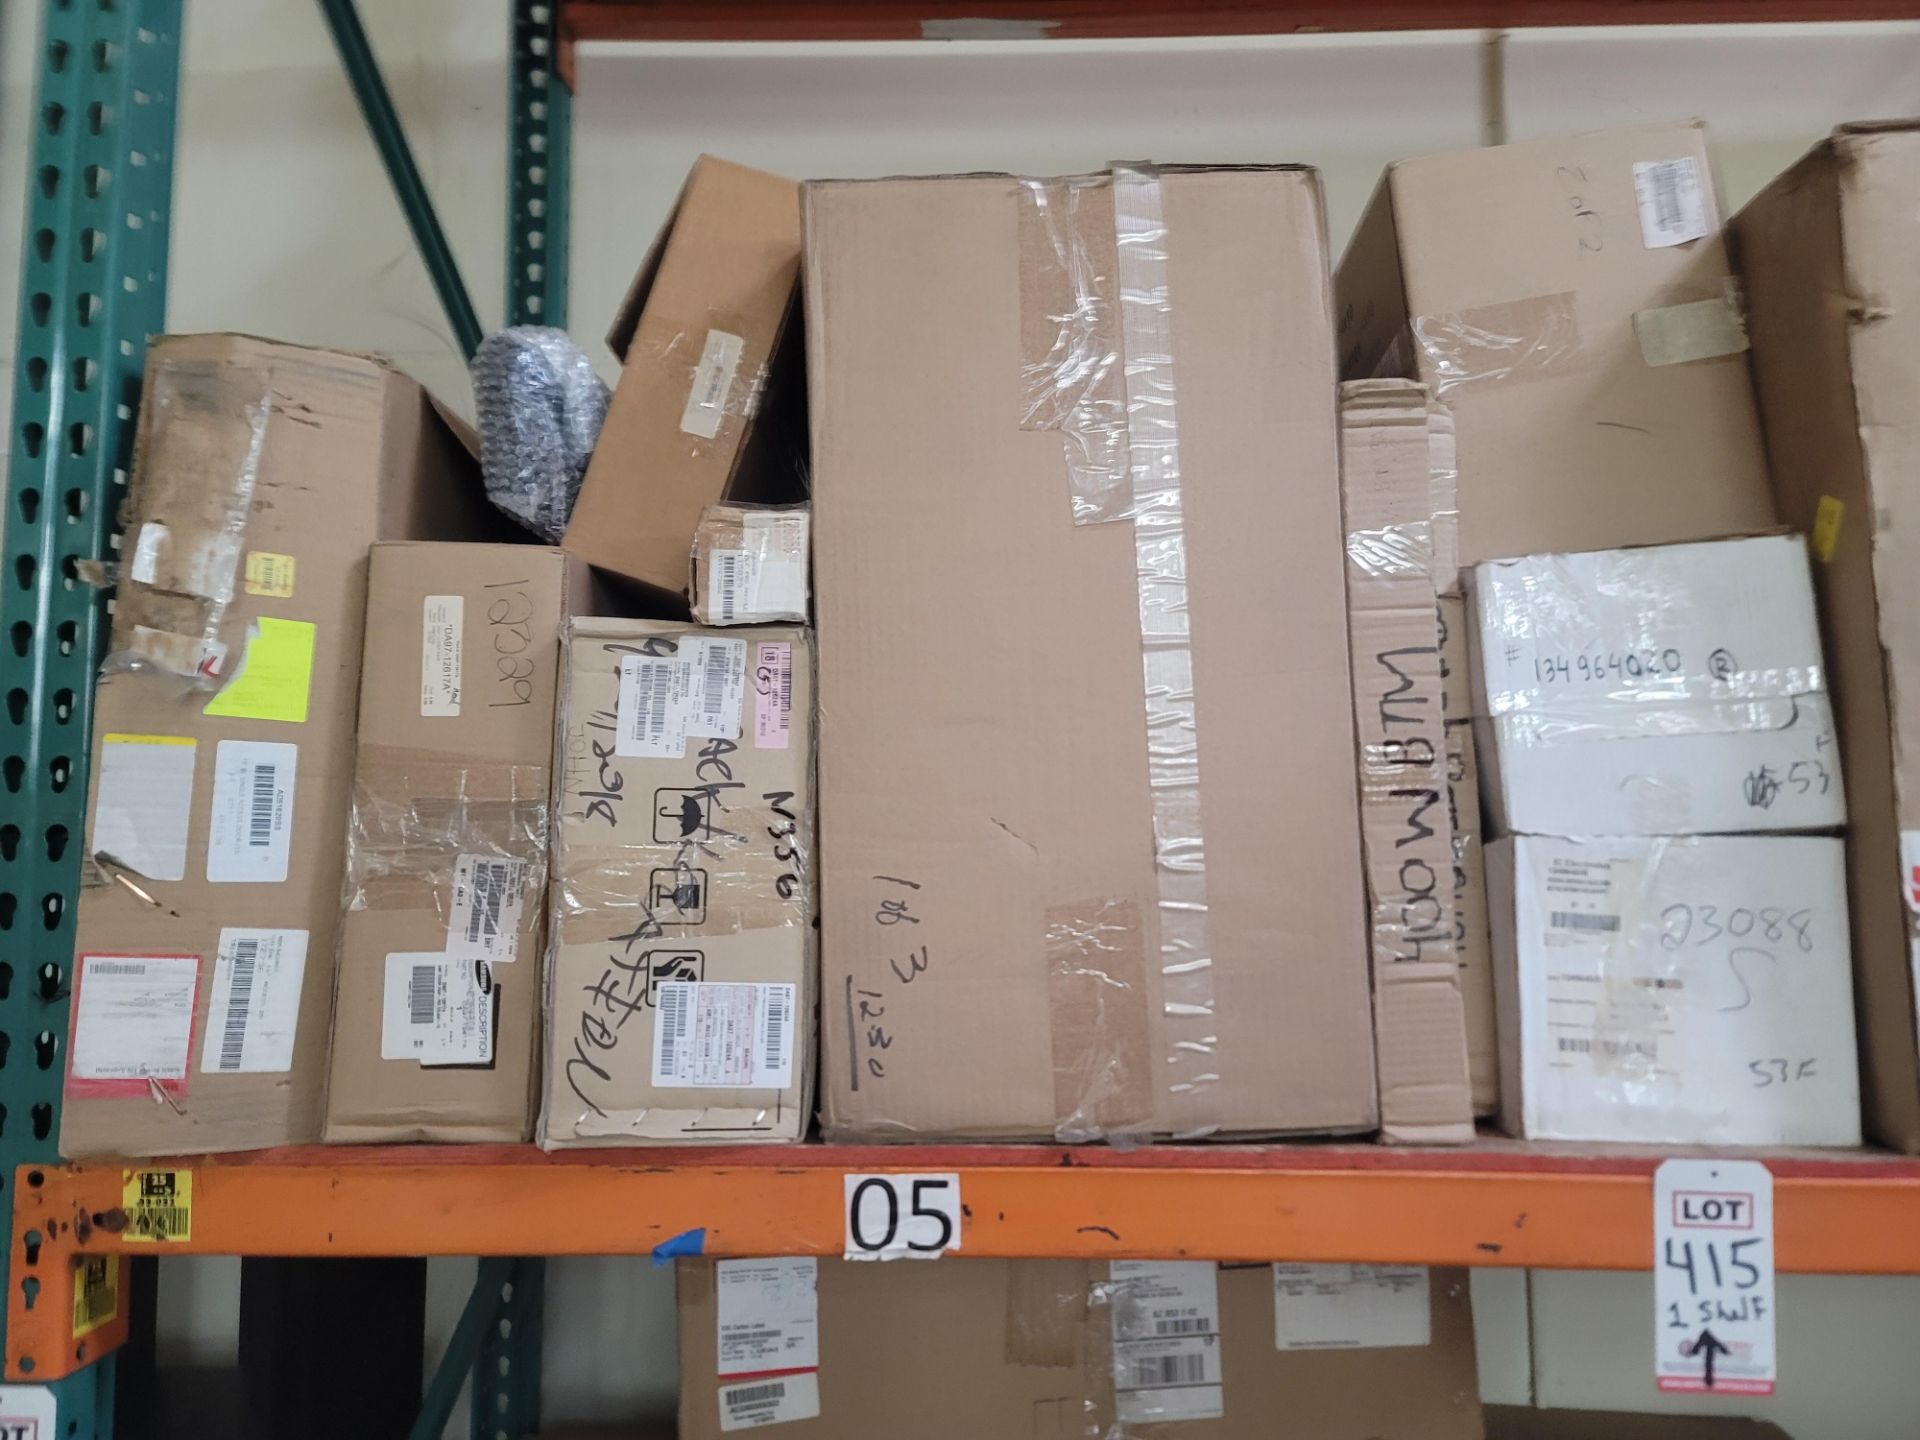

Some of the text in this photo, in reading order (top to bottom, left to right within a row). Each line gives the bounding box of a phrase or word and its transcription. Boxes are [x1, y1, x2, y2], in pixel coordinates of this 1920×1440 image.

[764, 651, 776, 662] 18
[1533, 647, 1682, 683] 134964020
[1658, 902, 1815, 953] 23088
[478, 995, 490, 1058] DESCRIPTION
[849, 1177, 954, 1252] 05
[1683, 1198, 1745, 1222] LOT
[1665, 1236, 1763, 1295] 415
[1668, 1302, 1689, 1329] 1
